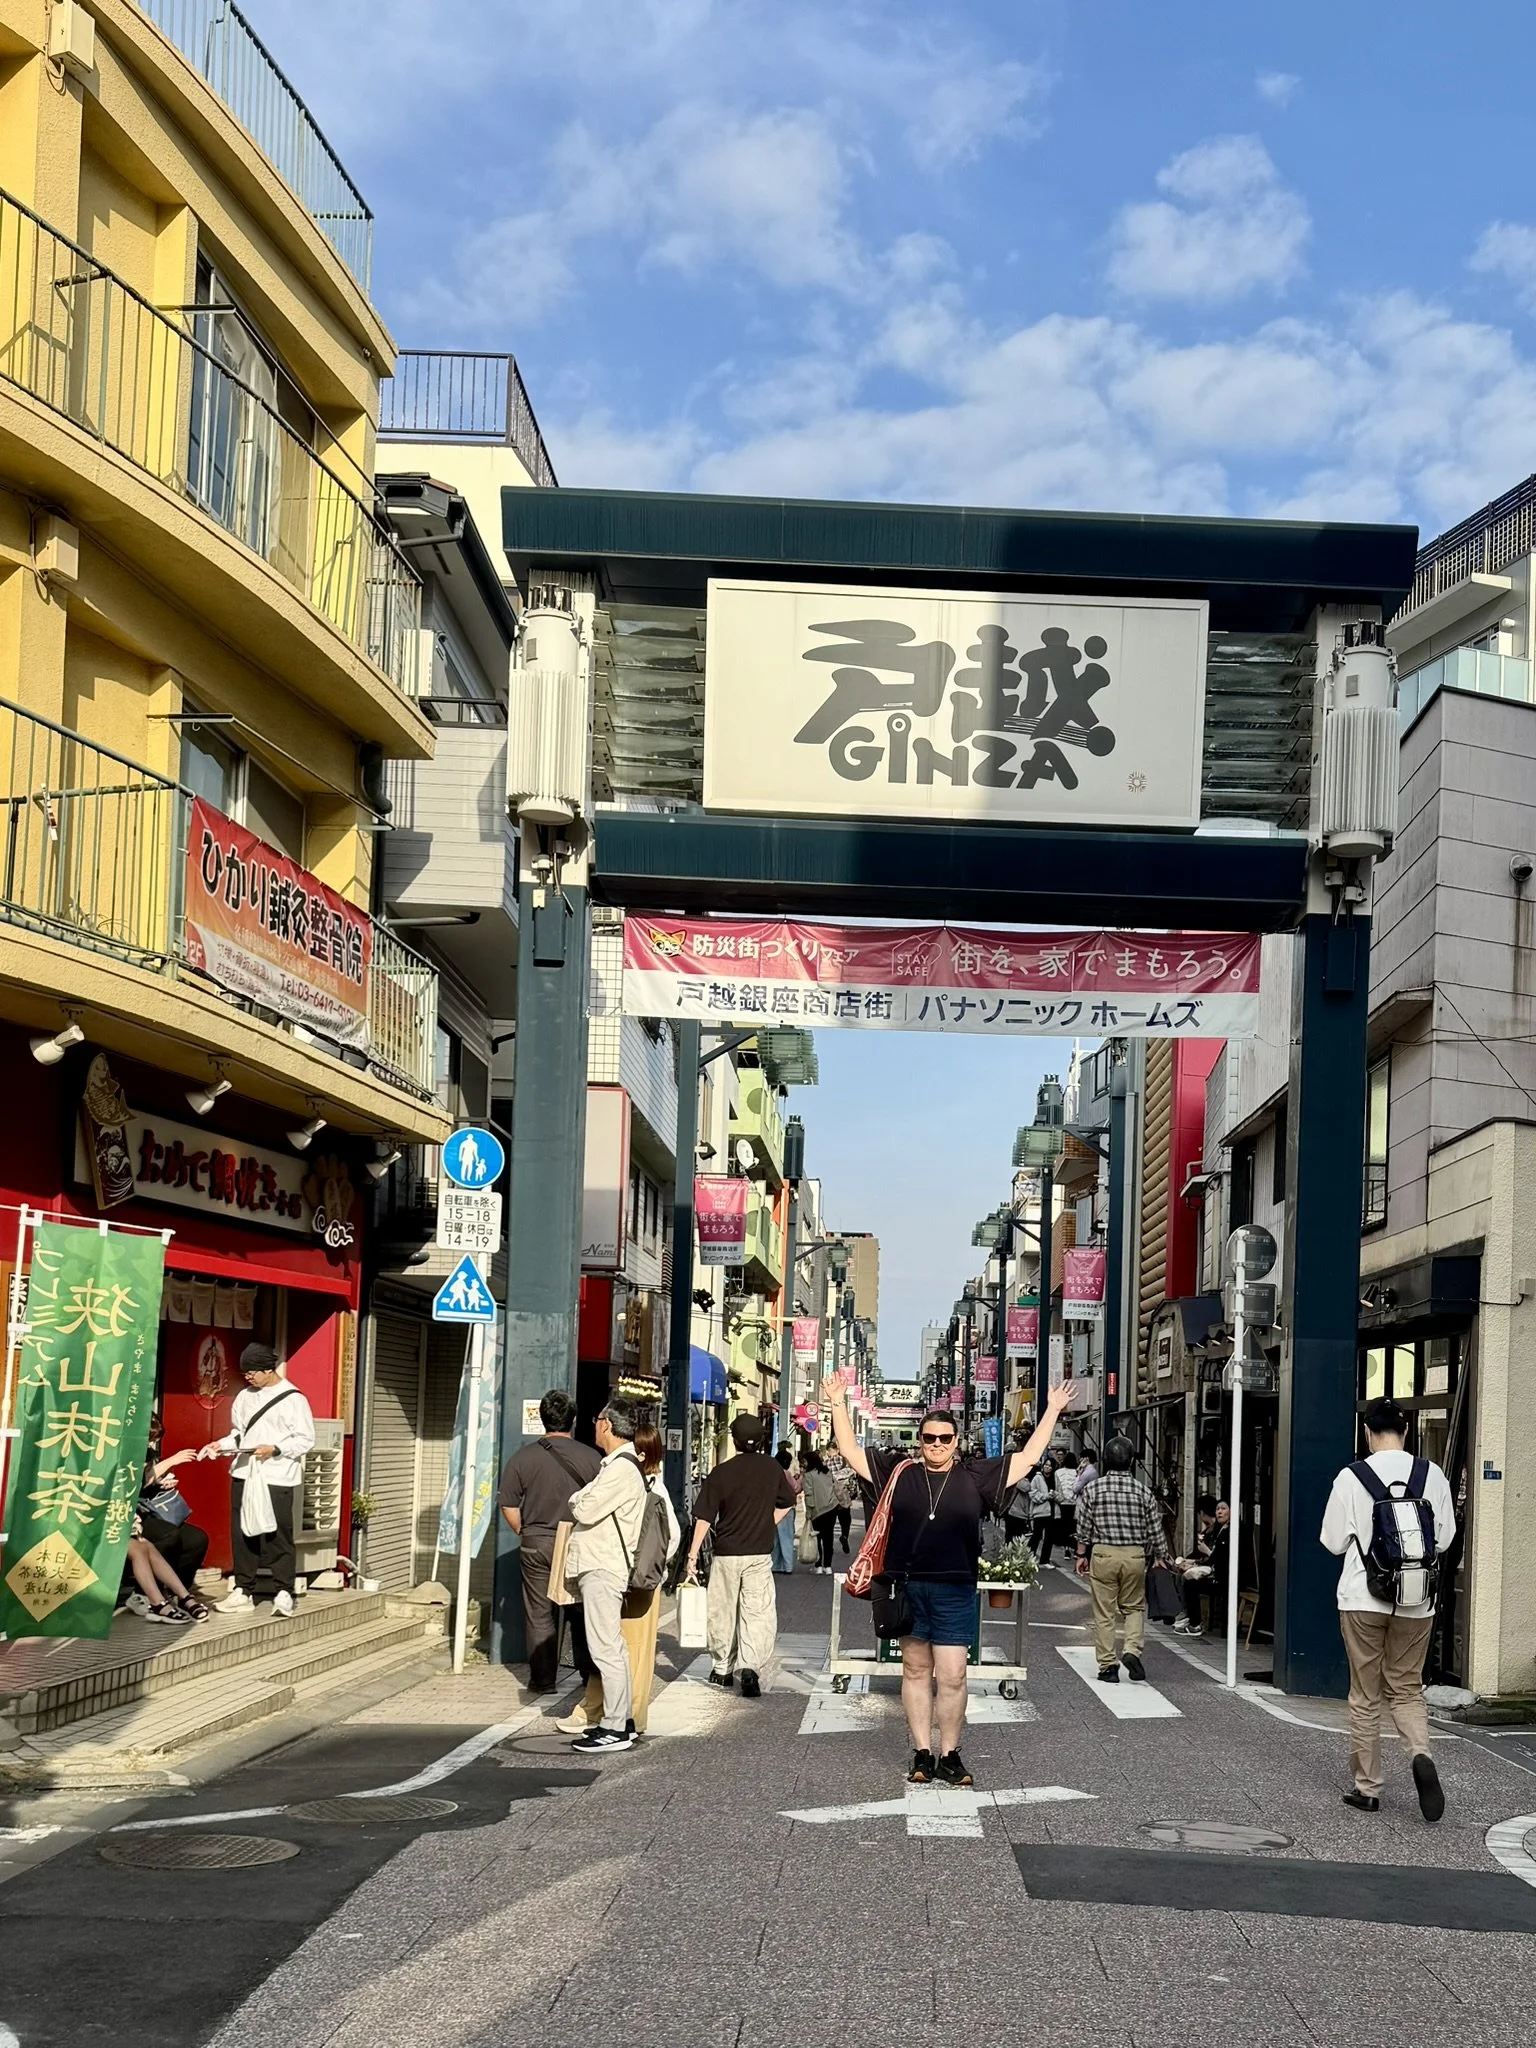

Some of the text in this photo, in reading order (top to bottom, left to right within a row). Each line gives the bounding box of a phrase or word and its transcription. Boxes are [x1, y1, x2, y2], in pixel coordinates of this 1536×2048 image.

[793, 618, 1116, 757] 戸越
[828, 712, 1079, 791] GINZA
[201, 828, 364, 987] ひかり鍼灸整骨院
[692, 934, 859, 963] 防災街づくりフェア
[896, 953, 930, 965] STAY
[950, 941, 1242, 980] 街を、家でまもろう。
[896, 966, 929, 977] SAFE
[676, 980, 893, 1020] 戸越銀座商店街
[444, 1194, 496, 1208] 自転車を除く
[448, 1208, 490, 1221] 15-18
[448, 1233, 490, 1248] 14-19
